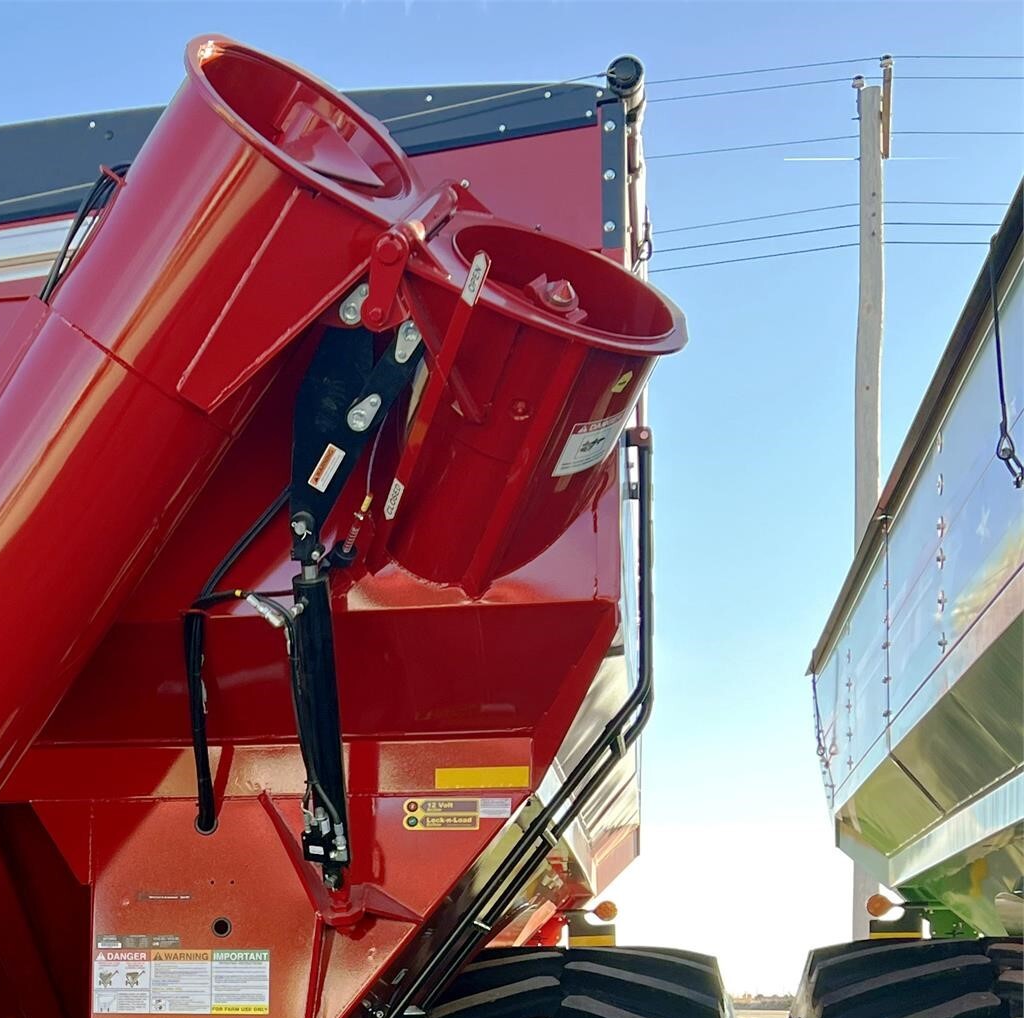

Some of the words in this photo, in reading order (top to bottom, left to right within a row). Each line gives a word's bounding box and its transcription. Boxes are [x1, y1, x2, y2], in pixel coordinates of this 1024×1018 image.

[468, 264, 482, 293] OPEN
[386, 482, 401, 516] CLOSED
[106, 952, 147, 961] DANGER
[164, 952, 209, 961] WARNING
[213, 952, 269, 961] IMPORTANT
